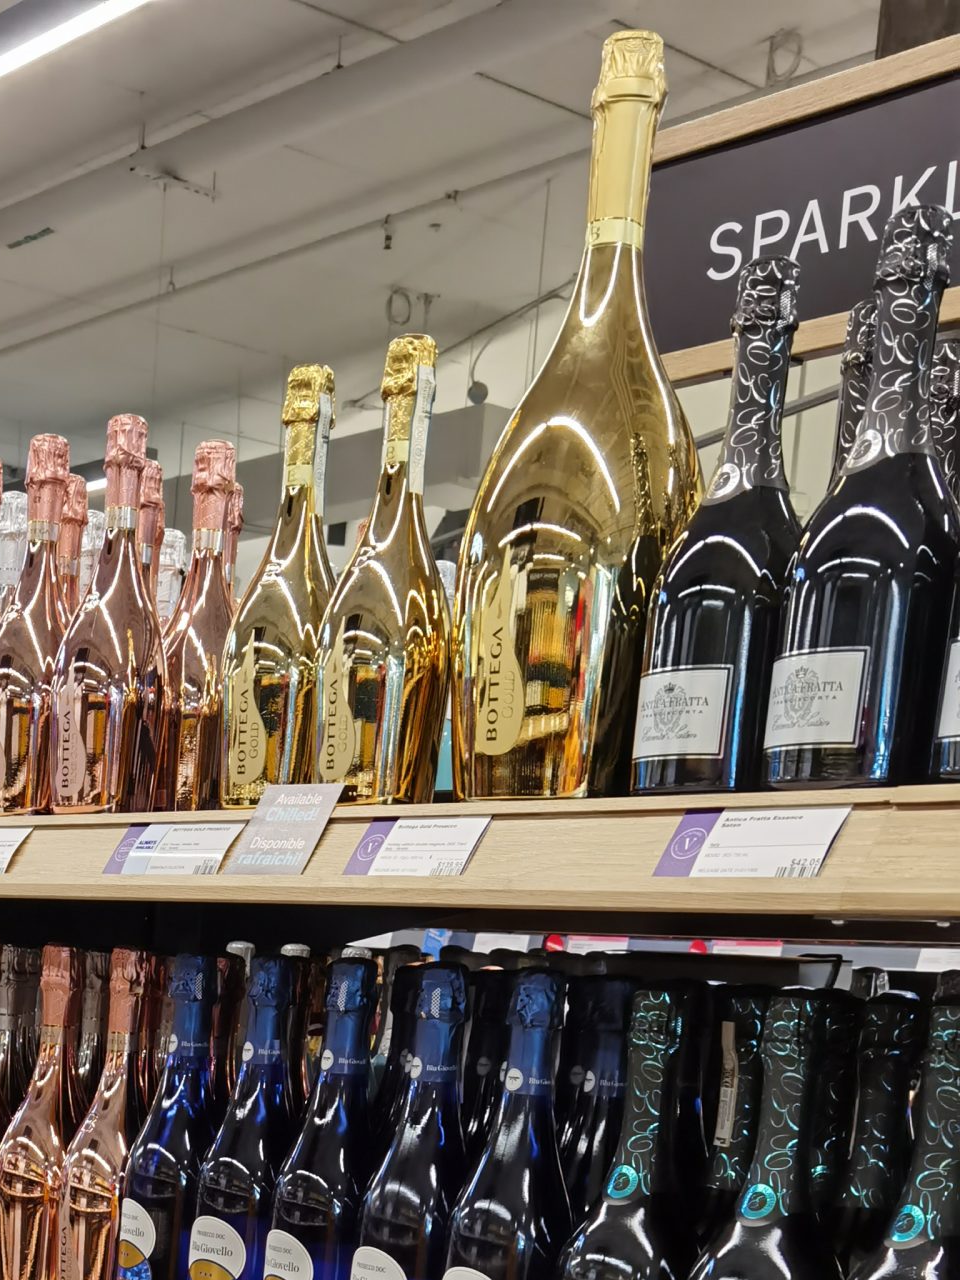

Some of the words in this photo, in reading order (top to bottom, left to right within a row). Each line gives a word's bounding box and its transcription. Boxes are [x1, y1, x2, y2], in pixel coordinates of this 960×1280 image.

[485, 627, 504, 742] BOTTEGA
[800, 681, 843, 693] FRATTA
[502, 671, 516, 721] GOLD
[669, 696, 709, 707] FRATTA
[237, 688, 249, 776] BOTTEGA
[326, 679, 338, 771] BOTTEGA
[250, 721, 260, 760] GOLD
[337, 714, 349, 753] GOLD
[62, 710, 70, 789] BOTTEGA
[276, 793, 323, 805] Available
[265, 807, 320, 823] Chilled!
[250, 836, 306, 851] Disponible
[790, 858, 821, 867] $42.05
[200, 1242, 234, 1258] Giovello
[271, 1258, 300, 1273] Giovello
[375, 1266, 387, 1274] DOC
